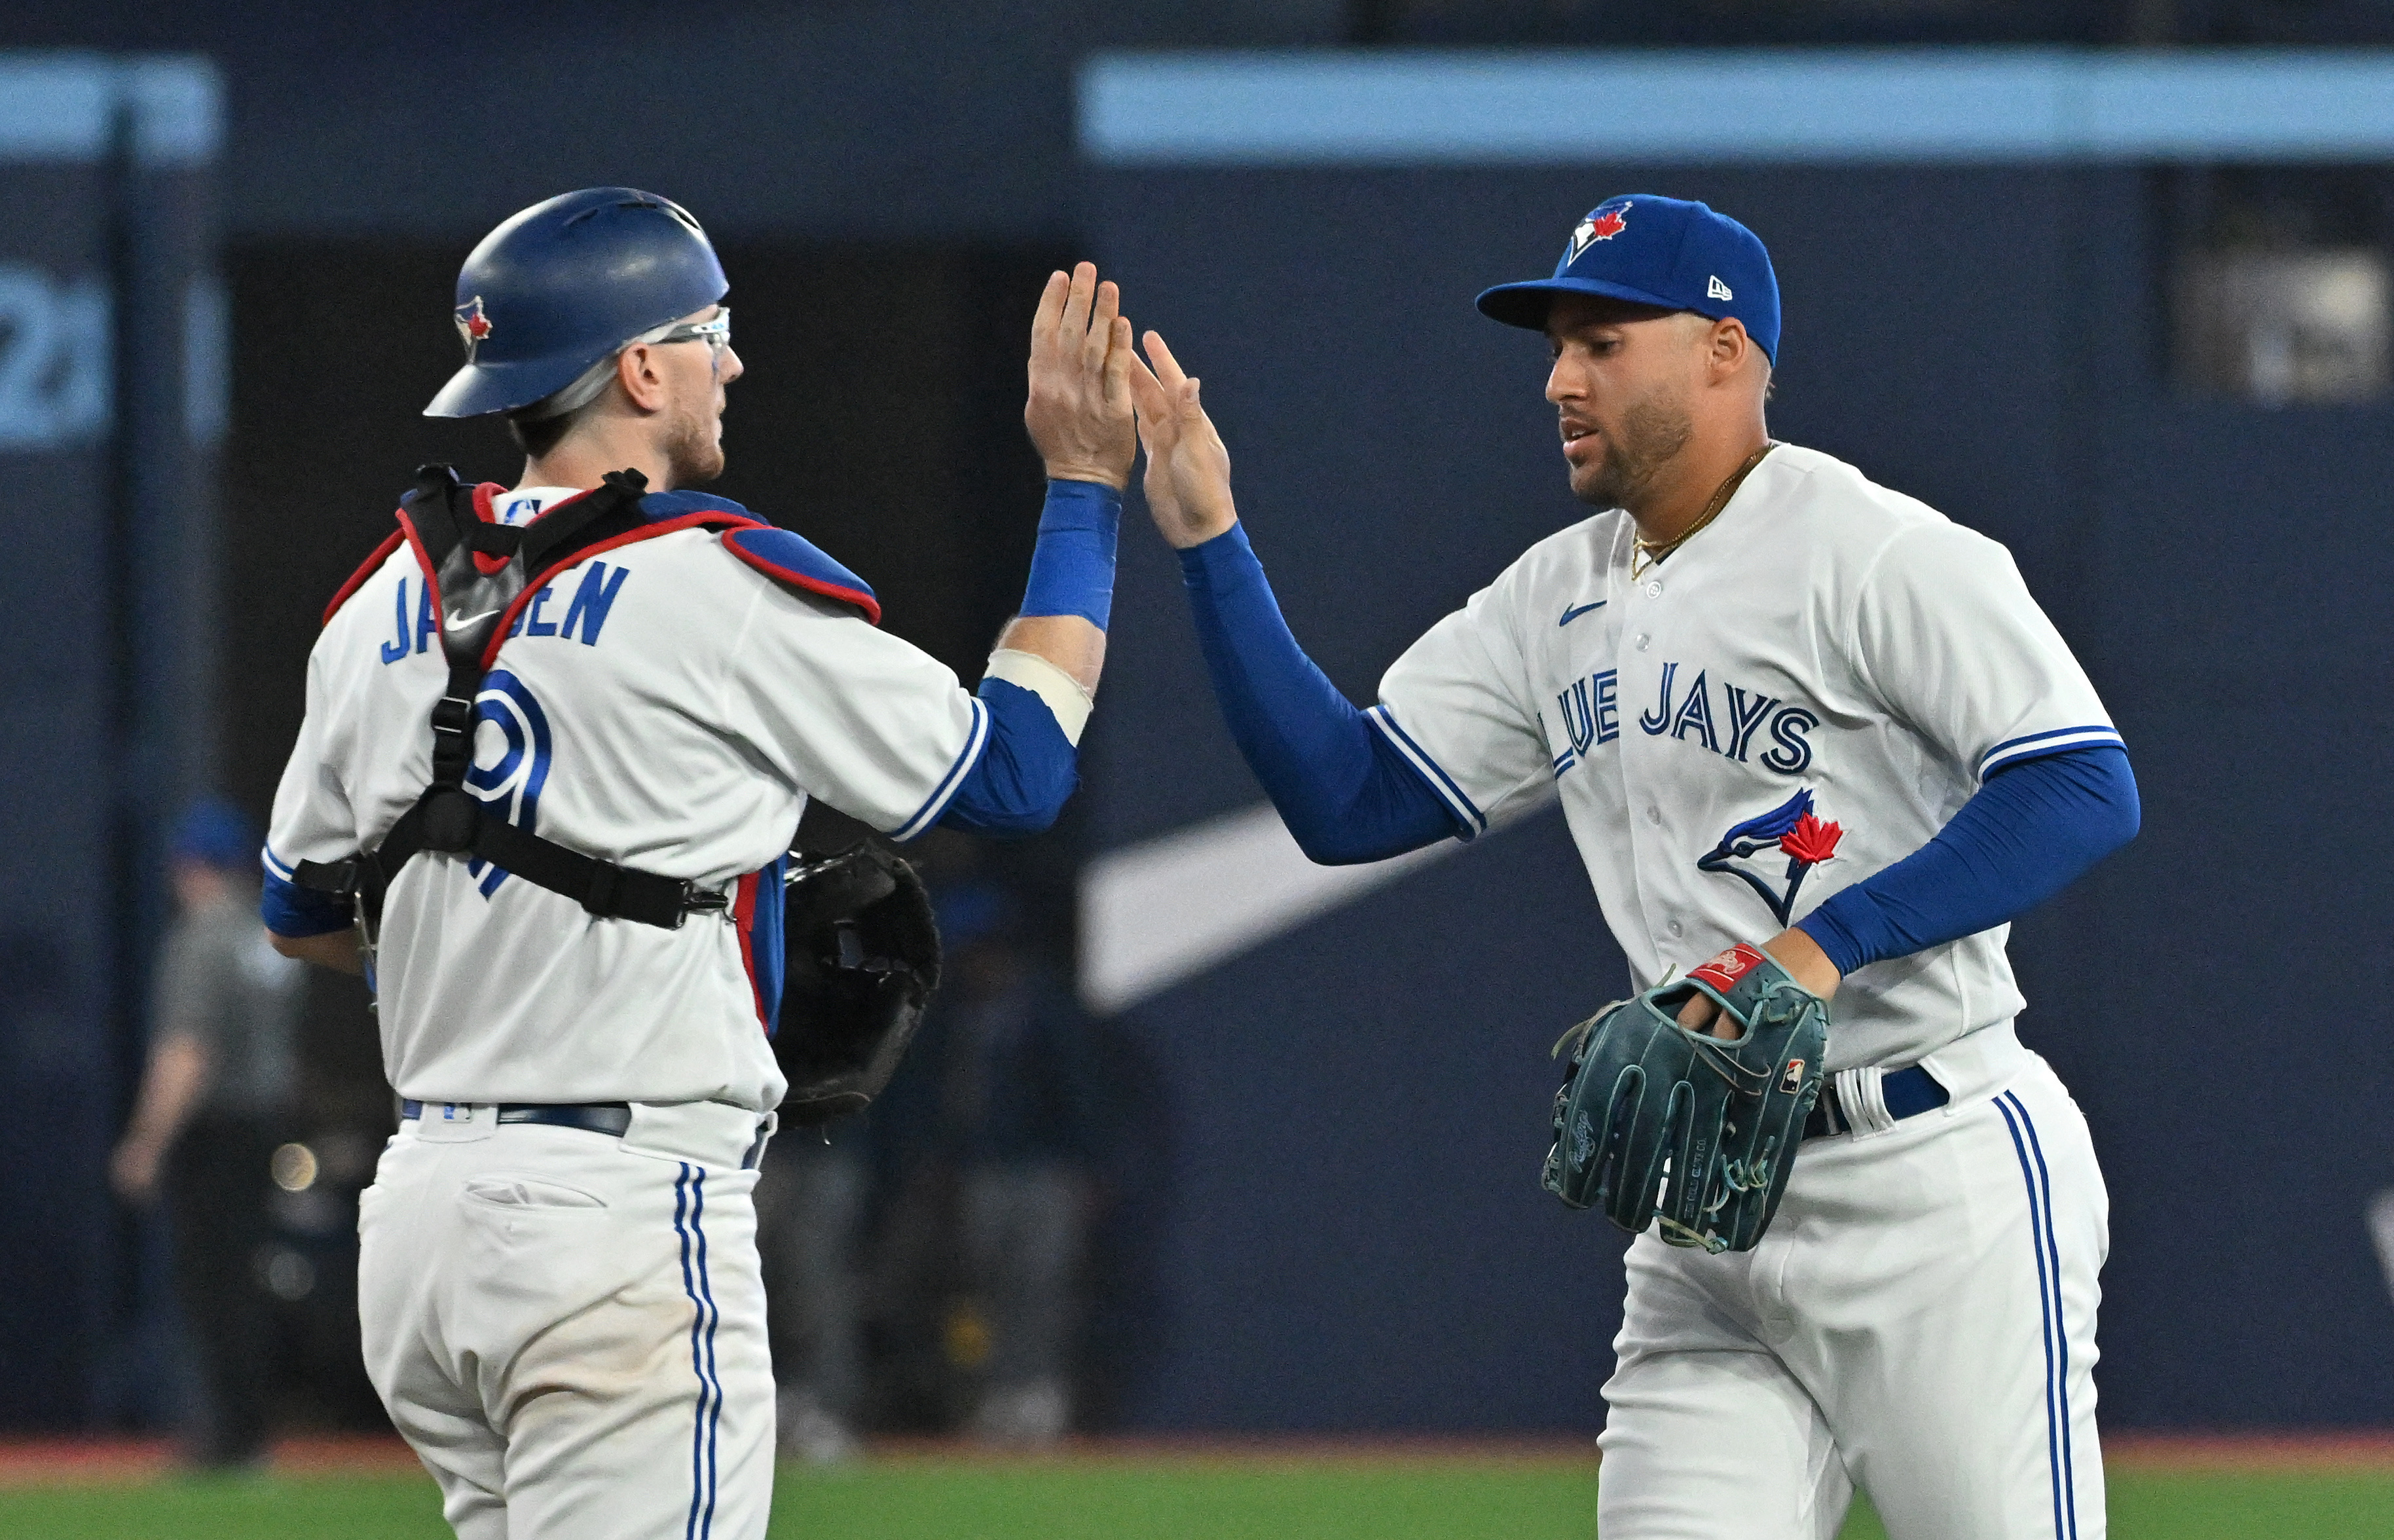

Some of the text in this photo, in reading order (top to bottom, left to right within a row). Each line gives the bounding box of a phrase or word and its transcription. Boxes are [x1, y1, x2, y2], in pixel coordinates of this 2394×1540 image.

[381, 560, 630, 665] JAEN
[1640, 662, 1820, 775] JAYS
[461, 669, 552, 900] 9
